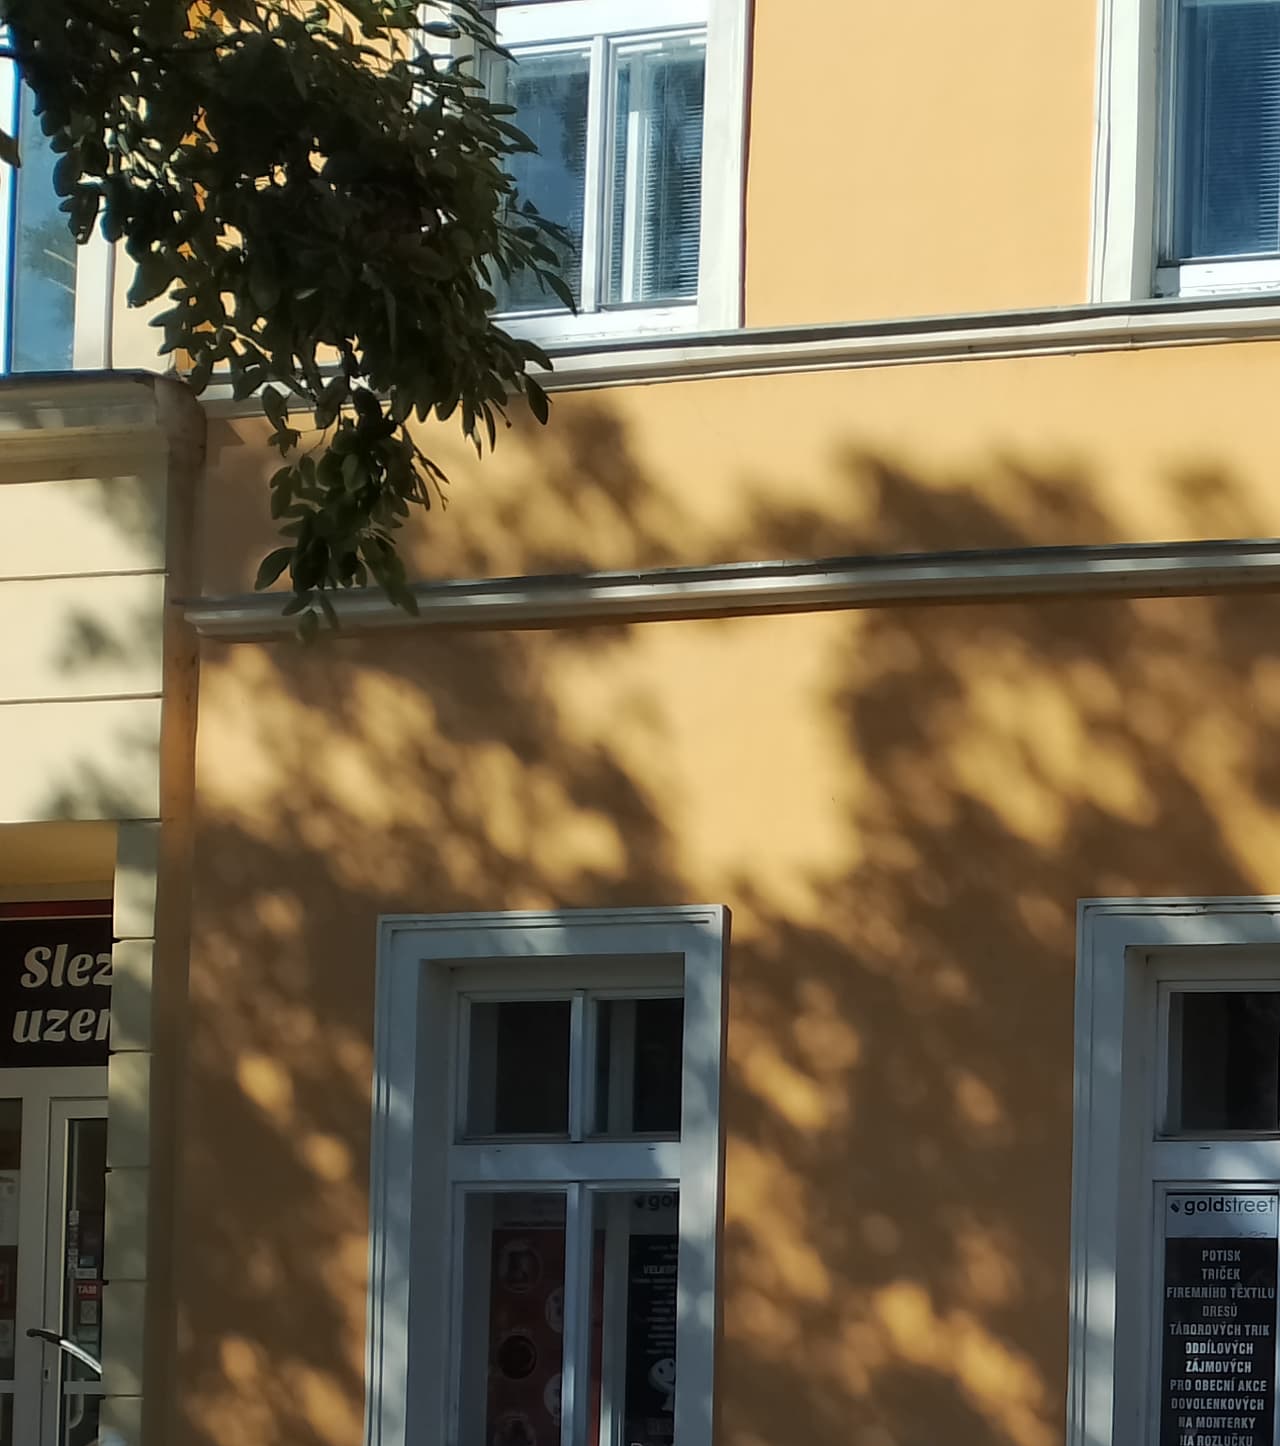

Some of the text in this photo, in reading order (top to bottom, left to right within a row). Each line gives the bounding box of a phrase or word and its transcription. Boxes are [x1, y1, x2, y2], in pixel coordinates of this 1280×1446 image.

[1184, 1197, 1277, 1216] goldstreet
[1202, 1249, 1241, 1261] POTISK
[1201, 1265, 1241, 1280] TRIČEK
[1166, 1284, 1274, 1298] FIREMNÍHO TEXTILU
[1202, 1302, 1238, 1317] DRESŮ
[1169, 1321, 1270, 1336] TÁBOROVÝCH TRIK
[1185, 1339, 1254, 1354] ODDÍLOVÝCH
[1185, 1357, 1252, 1373] ZÁJMOVÝCH
[1170, 1377, 1267, 1392] PRO OBECNÍ AKCE
[1171, 1396, 1264, 1410] DOVOLENKOVÝCH
[1178, 1416, 1193, 1428] NA
[1179, 1433, 1253, 1446] NA ROZLUČKU
